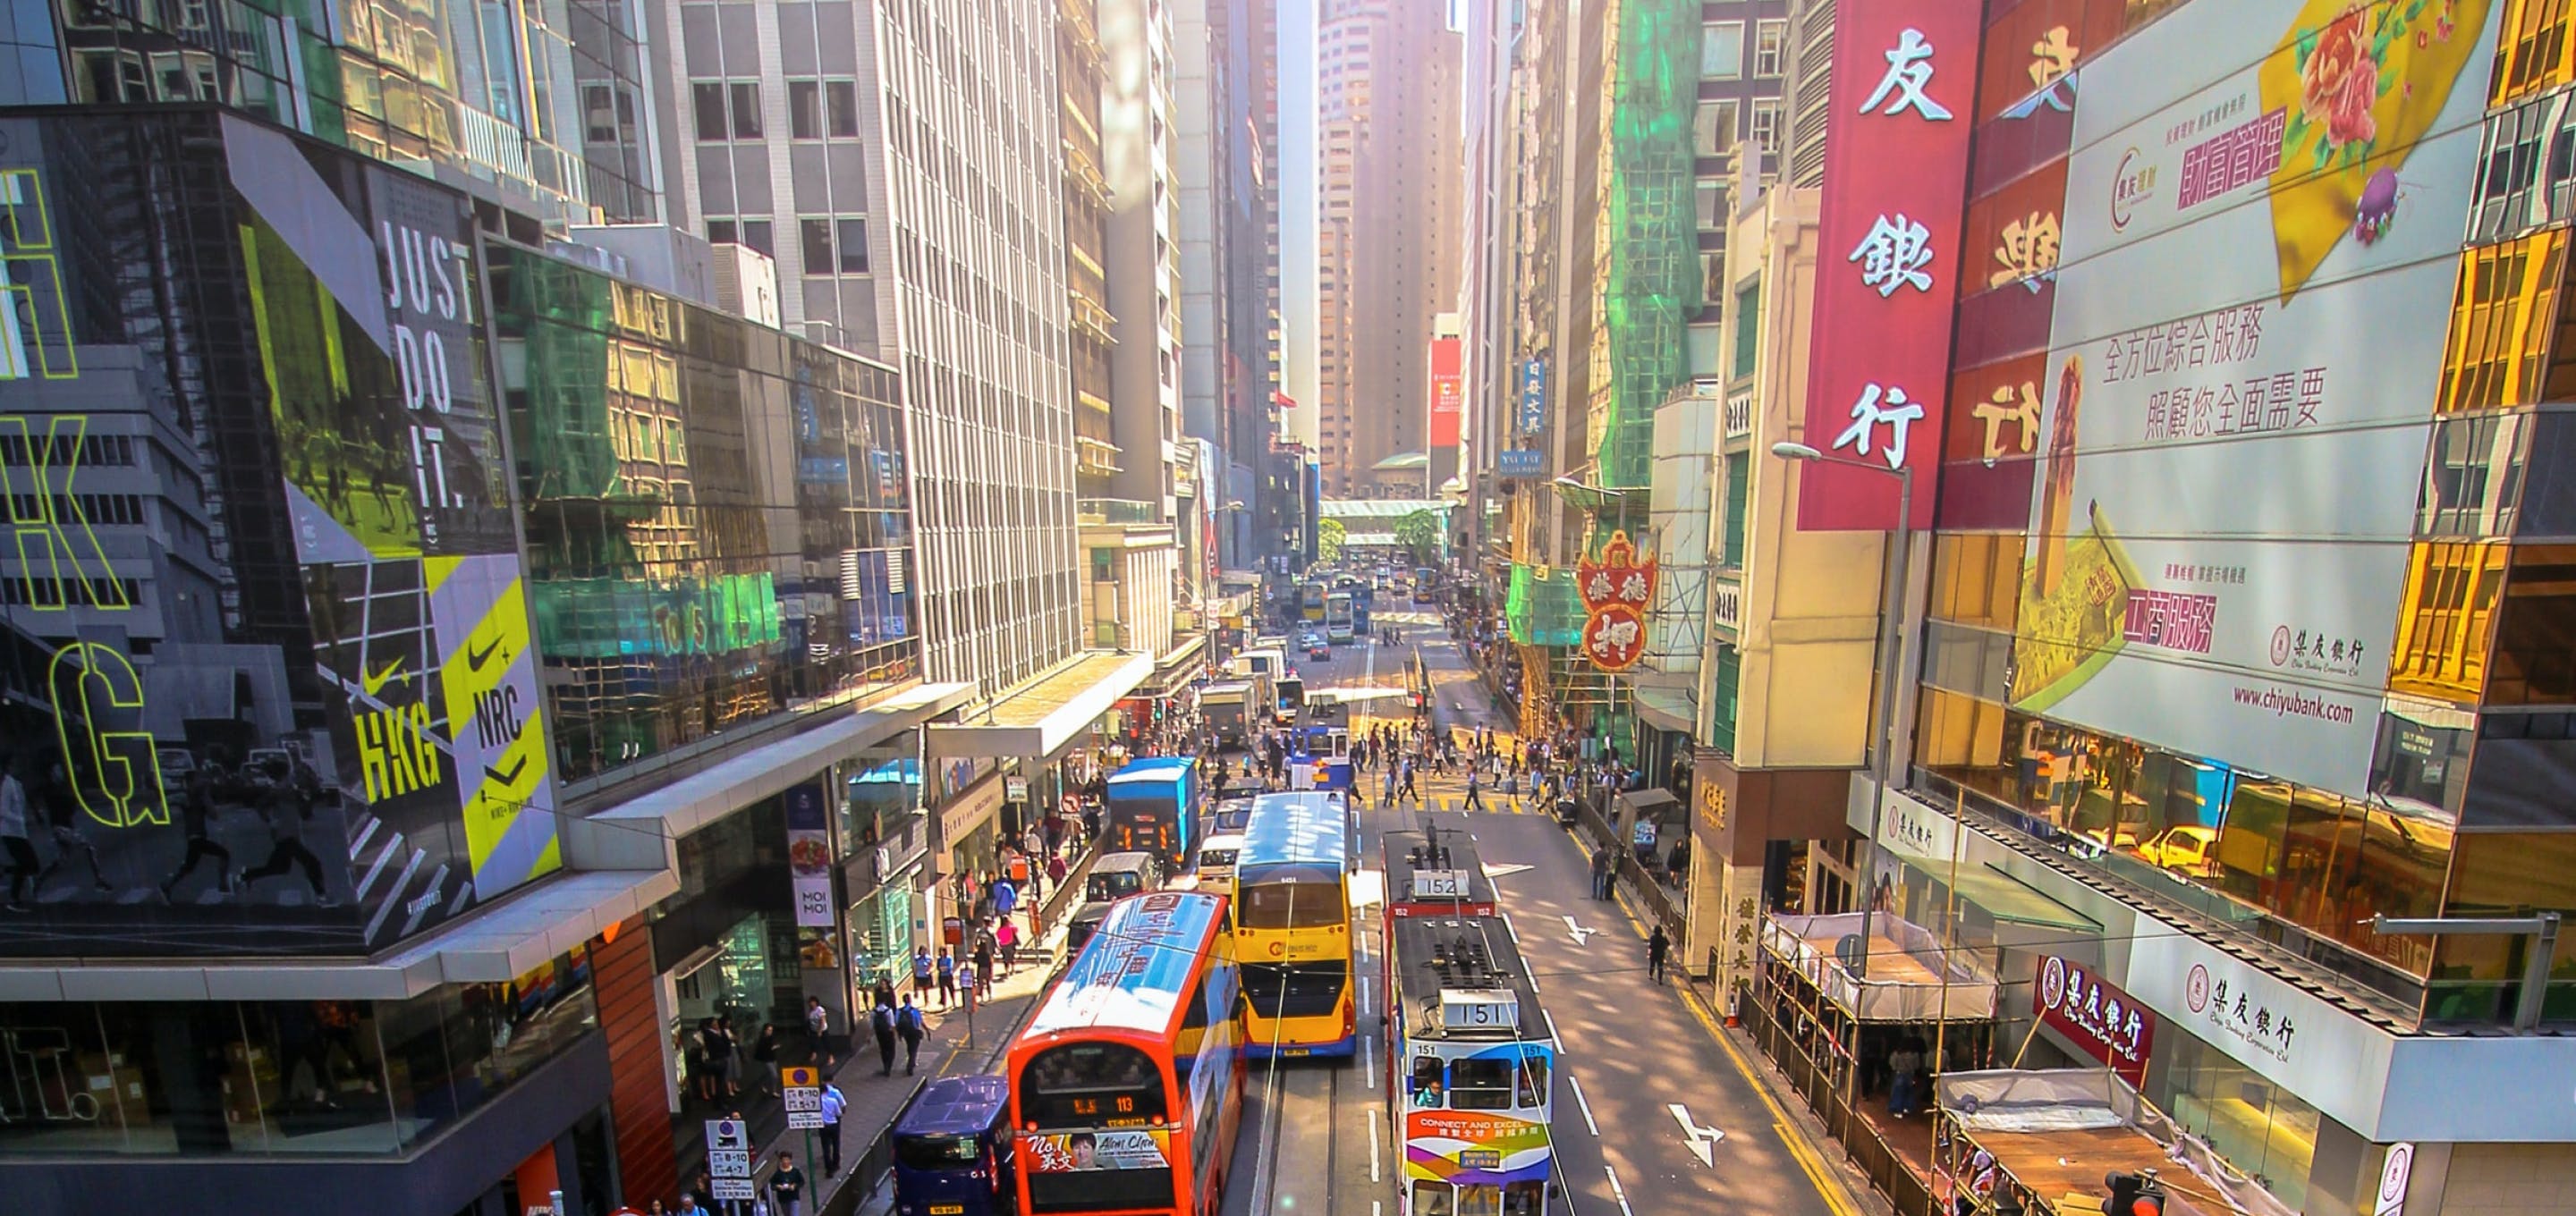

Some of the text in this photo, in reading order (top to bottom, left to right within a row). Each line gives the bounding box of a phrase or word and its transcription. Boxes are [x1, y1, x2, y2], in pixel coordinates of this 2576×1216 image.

[2180, 110, 2285, 206] 財富管理
[383, 220, 475, 325] JUST
[2103, 301, 2265, 384] 全方位綜合服務
[394, 324, 452, 414] DO
[2144, 367, 2327, 441] 照顧您全面需要
[410, 424, 463, 509] IT.
[1592, 614, 1639, 662] 押
[2124, 594, 2216, 653] 工商服務
[471, 685, 523, 749] NRC
[2233, 686, 2354, 725] www.chiyubank.com
[354, 701, 442, 805] HKG
[802, 891, 826, 902] MOI
[1427, 879, 1456, 894] 152
[803, 903, 827, 914] MOI
[1395, 908, 1408, 916] 152
[1462, 1004, 1500, 1024] 151
[2066, 968, 2142, 1047] 集友銀行
[2213, 978, 2294, 1051] 集友銀行
[1417, 1045, 1436, 1056] 151
[1524, 1045, 1542, 1056] 151
[1115, 1097, 1133, 1113] 113
[1419, 1118, 1525, 1129] CONNECT AND EXCEL
[724, 1153, 748, 1162] 8-10
[1027, 1134, 1063, 1154] No.1
[1039, 1152, 1074, 1170] 英文
